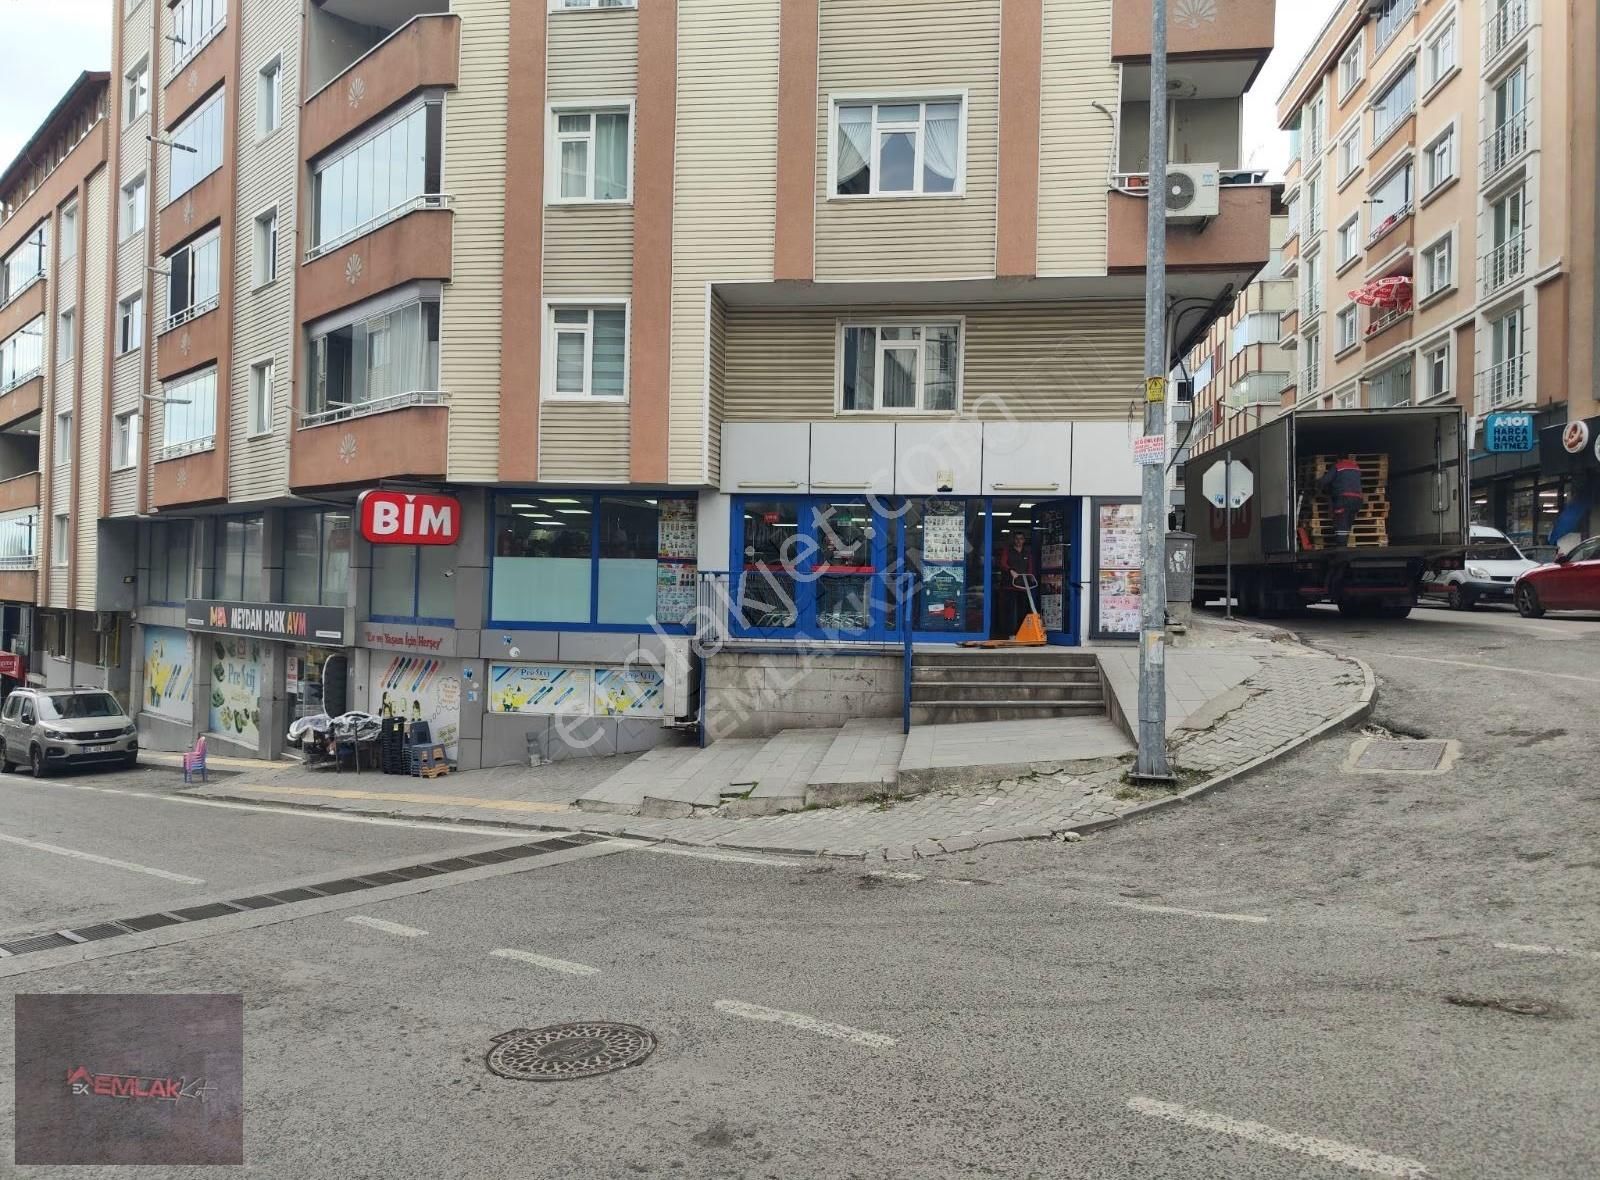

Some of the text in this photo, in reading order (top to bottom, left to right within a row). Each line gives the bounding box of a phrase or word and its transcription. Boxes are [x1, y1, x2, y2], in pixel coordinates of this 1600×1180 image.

[1494, 427, 1528, 435] HARCA
[1494, 435, 1528, 443] HARCA
[373, 495, 451, 536] BİM
[231, 608, 307, 637] MEYDAN PARK AVM
